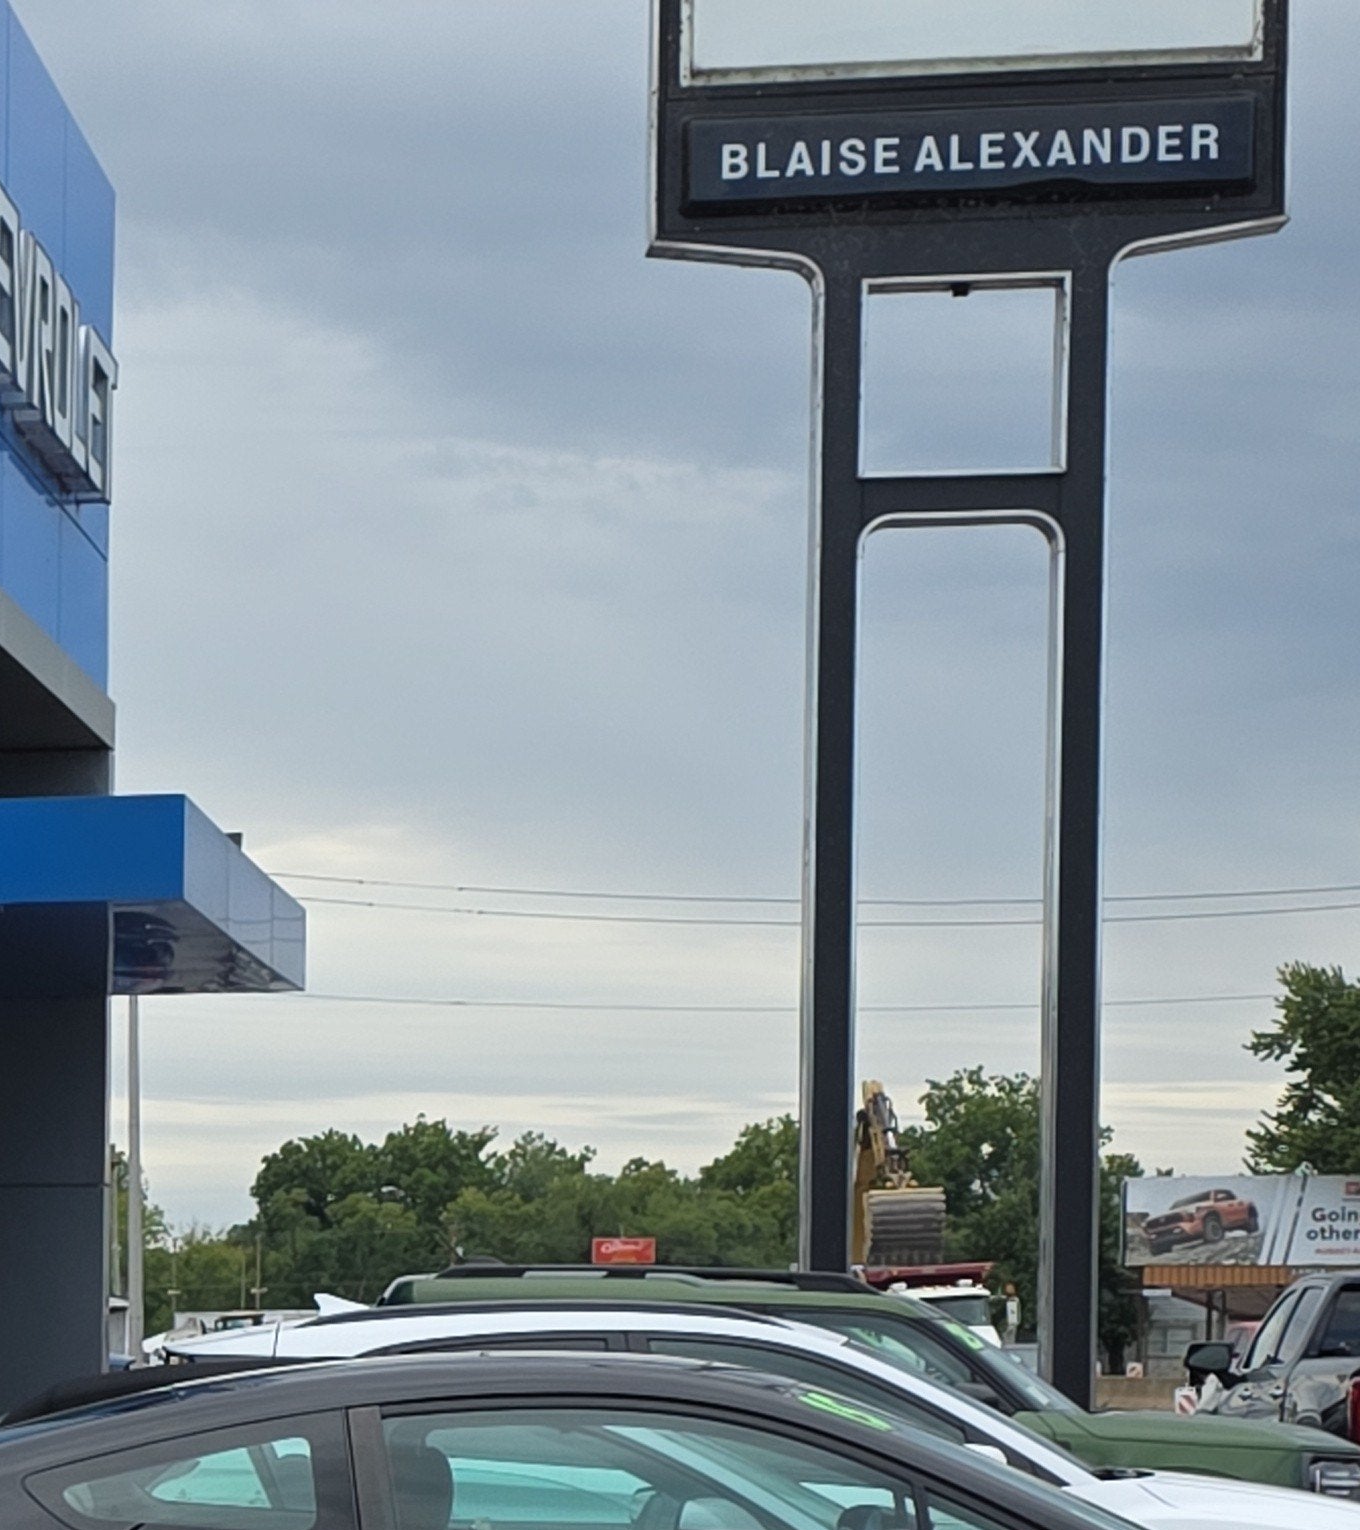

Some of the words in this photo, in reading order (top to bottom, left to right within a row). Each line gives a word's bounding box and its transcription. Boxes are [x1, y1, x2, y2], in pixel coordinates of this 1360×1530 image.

[720, 136, 900, 181] BLAISE
[914, 123, 1220, 173] ALEXANDER
[1311, 1206, 1360, 1224] Goin
